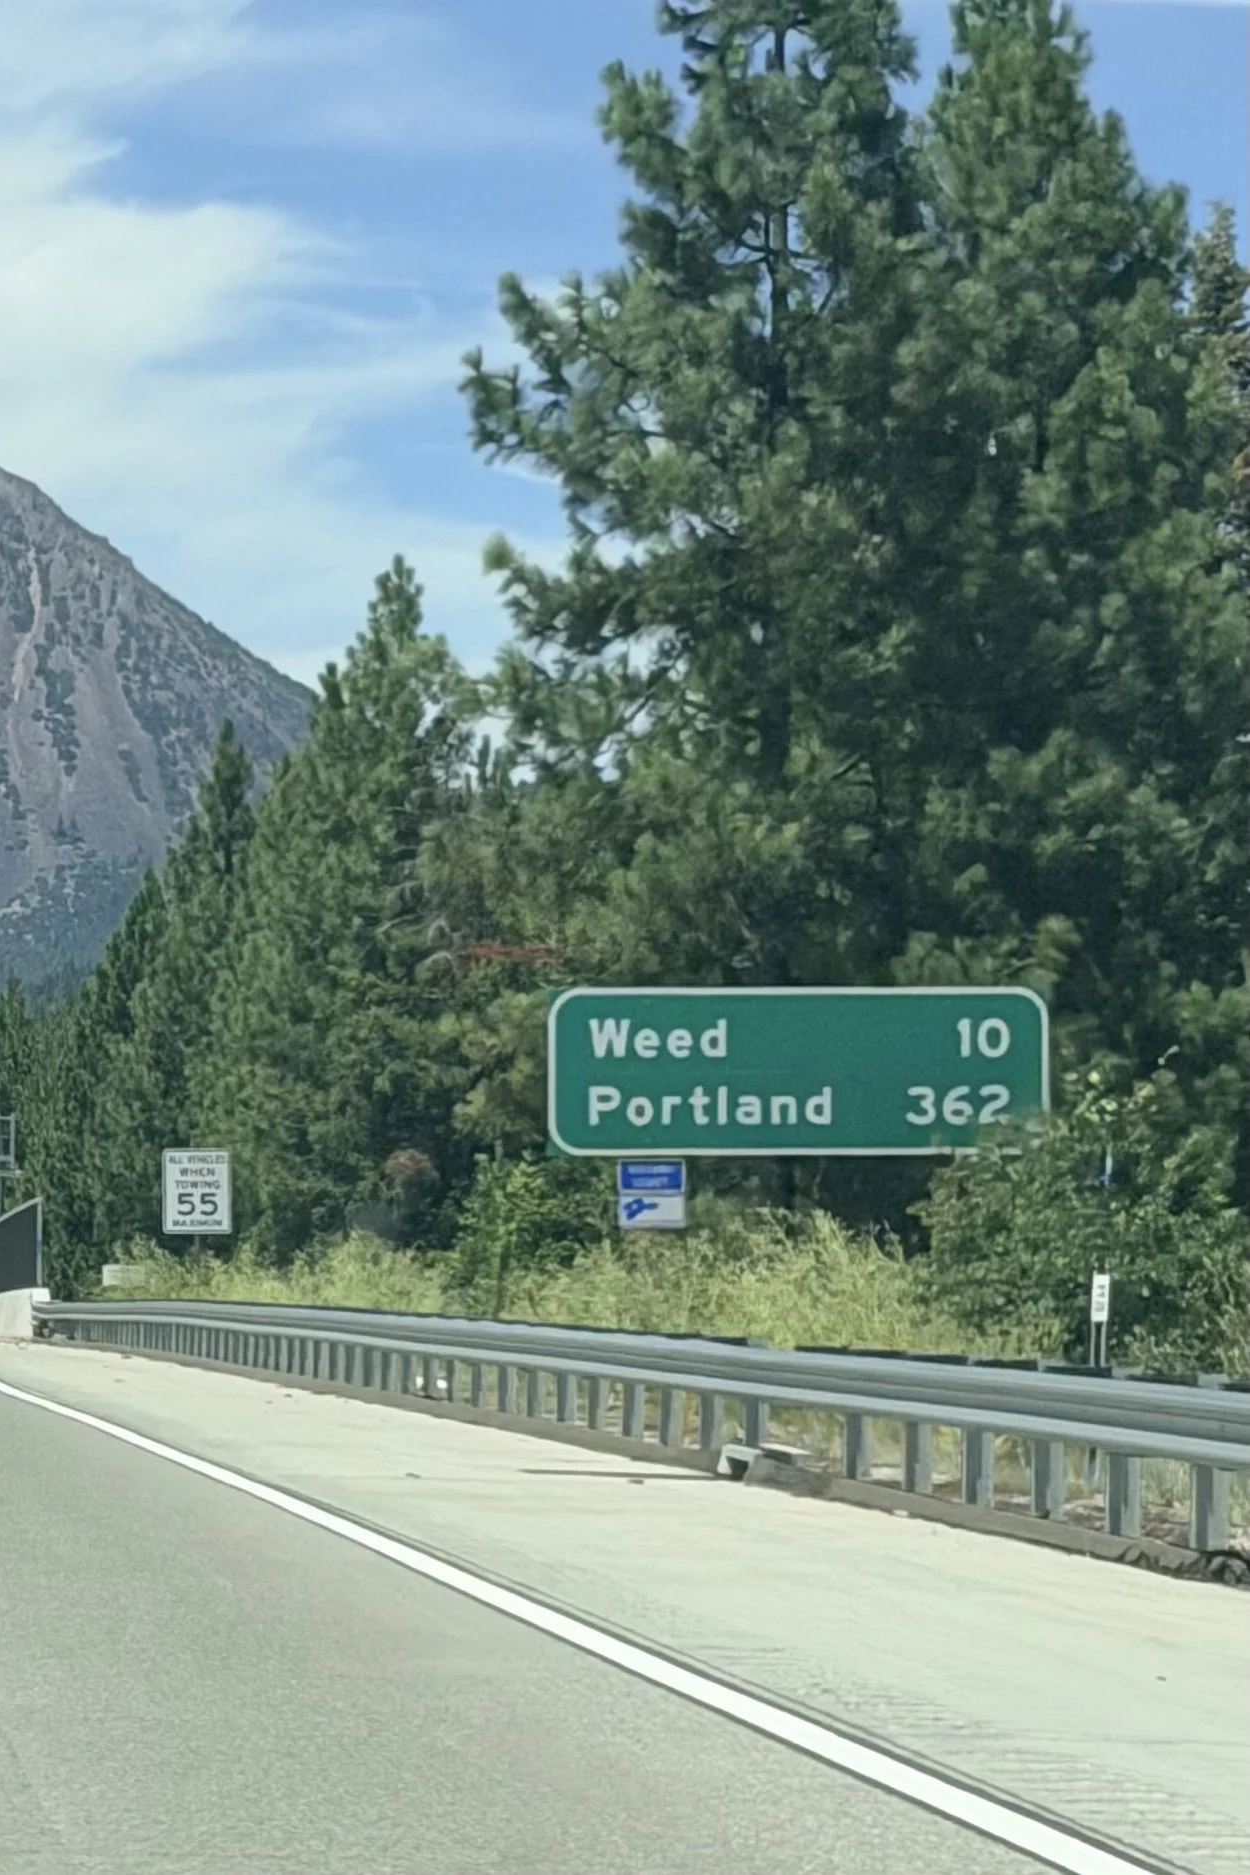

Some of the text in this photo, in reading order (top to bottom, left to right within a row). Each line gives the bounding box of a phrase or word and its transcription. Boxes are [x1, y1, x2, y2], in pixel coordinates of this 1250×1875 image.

[588, 1017, 1011, 1058] Weed 10
[588, 1084, 1011, 1127] Portland 362
[179, 1167, 216, 1177] WHEN
[174, 1180, 221, 1190] TOWING
[177, 1193, 219, 1216] 55
